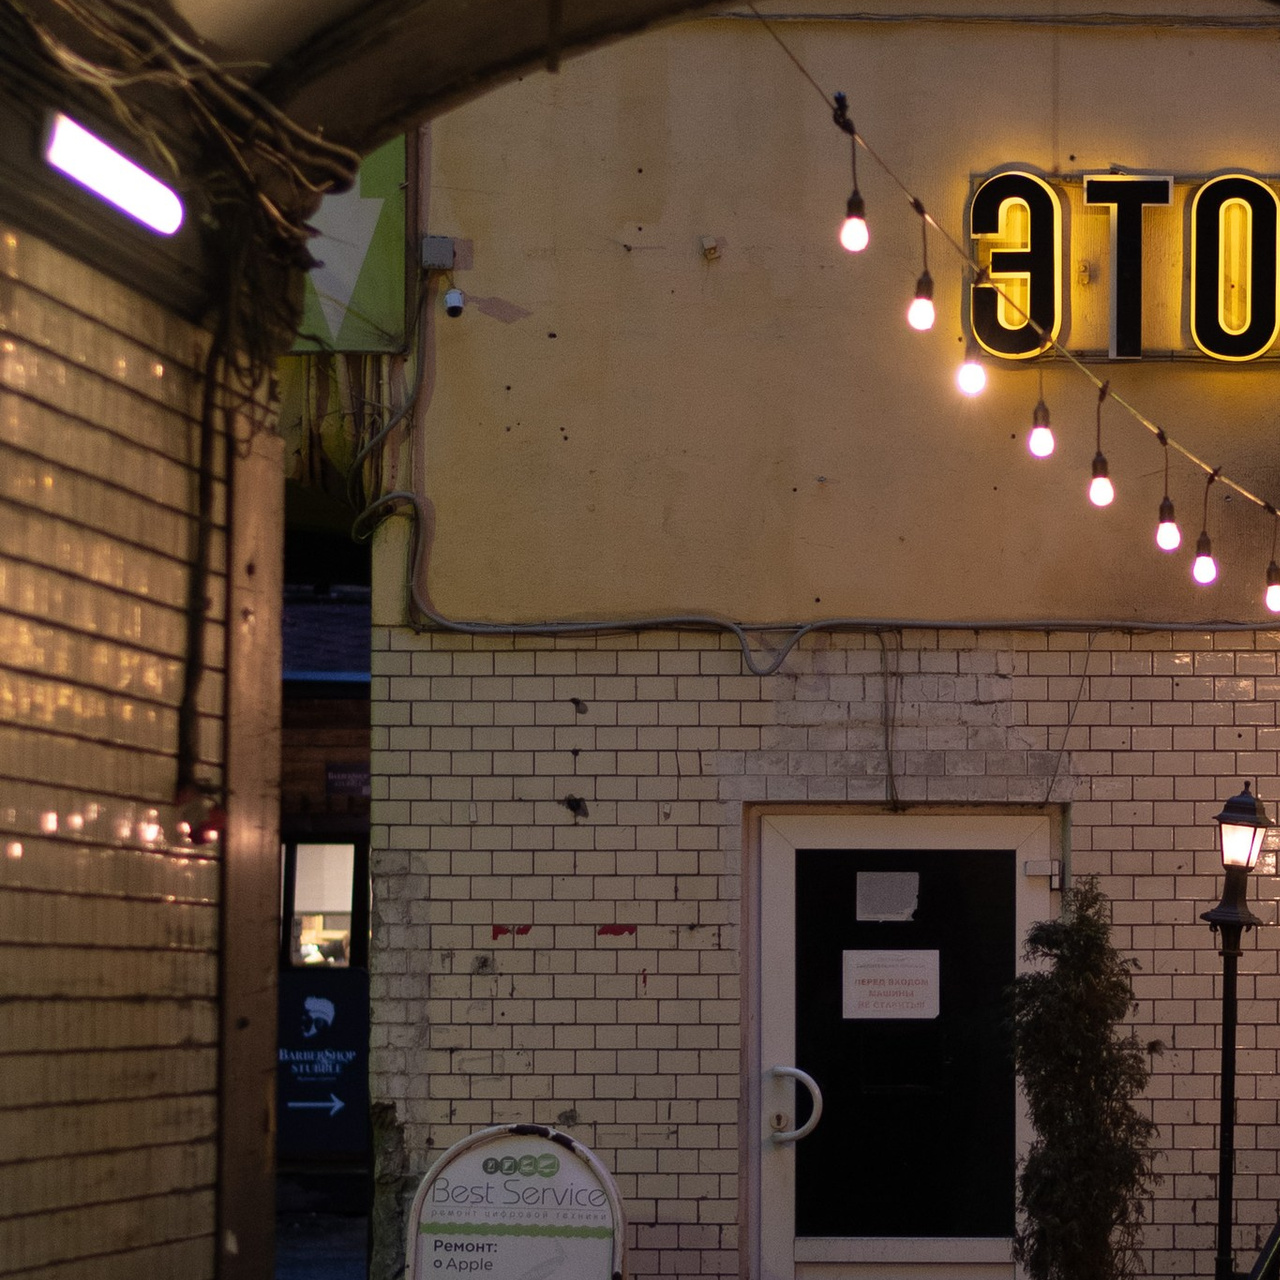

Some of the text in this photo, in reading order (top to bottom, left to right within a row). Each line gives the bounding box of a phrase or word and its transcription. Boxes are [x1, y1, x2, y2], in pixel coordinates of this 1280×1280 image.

[855, 978, 929, 987] ПЕРЕД ВХОДОМ
[869, 990, 914, 998] МАШИНЫ
[431, 1177, 608, 1207] Best Service
[431, 1208, 607, 1220] ремонт цифровой техники
[433, 1239, 498, 1253] Ремонт:
[446, 1257, 494, 1272] Apple
